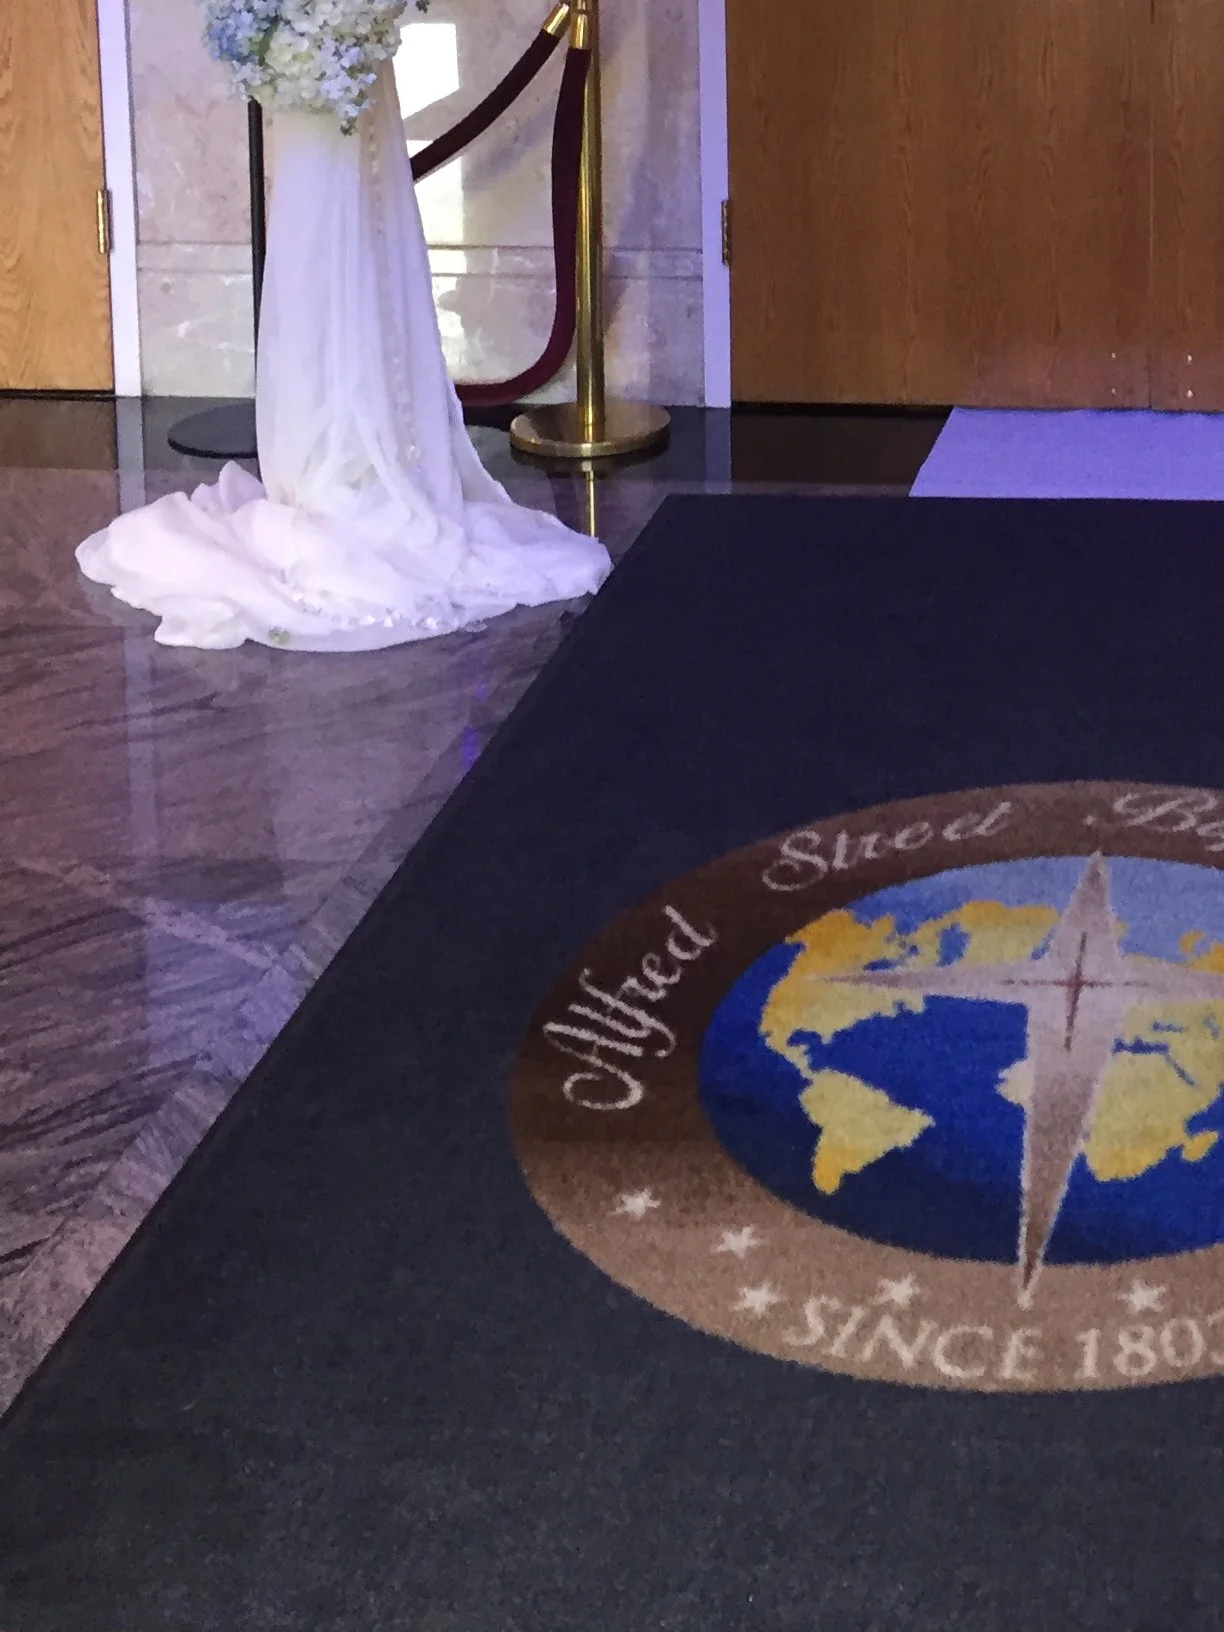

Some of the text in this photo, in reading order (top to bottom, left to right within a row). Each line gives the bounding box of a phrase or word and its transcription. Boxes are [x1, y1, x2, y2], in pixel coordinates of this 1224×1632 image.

[543, 905, 718, 1111] Alfred
[761, 801, 1013, 891] Street
[781, 1296, 1042, 1381] SINCE
